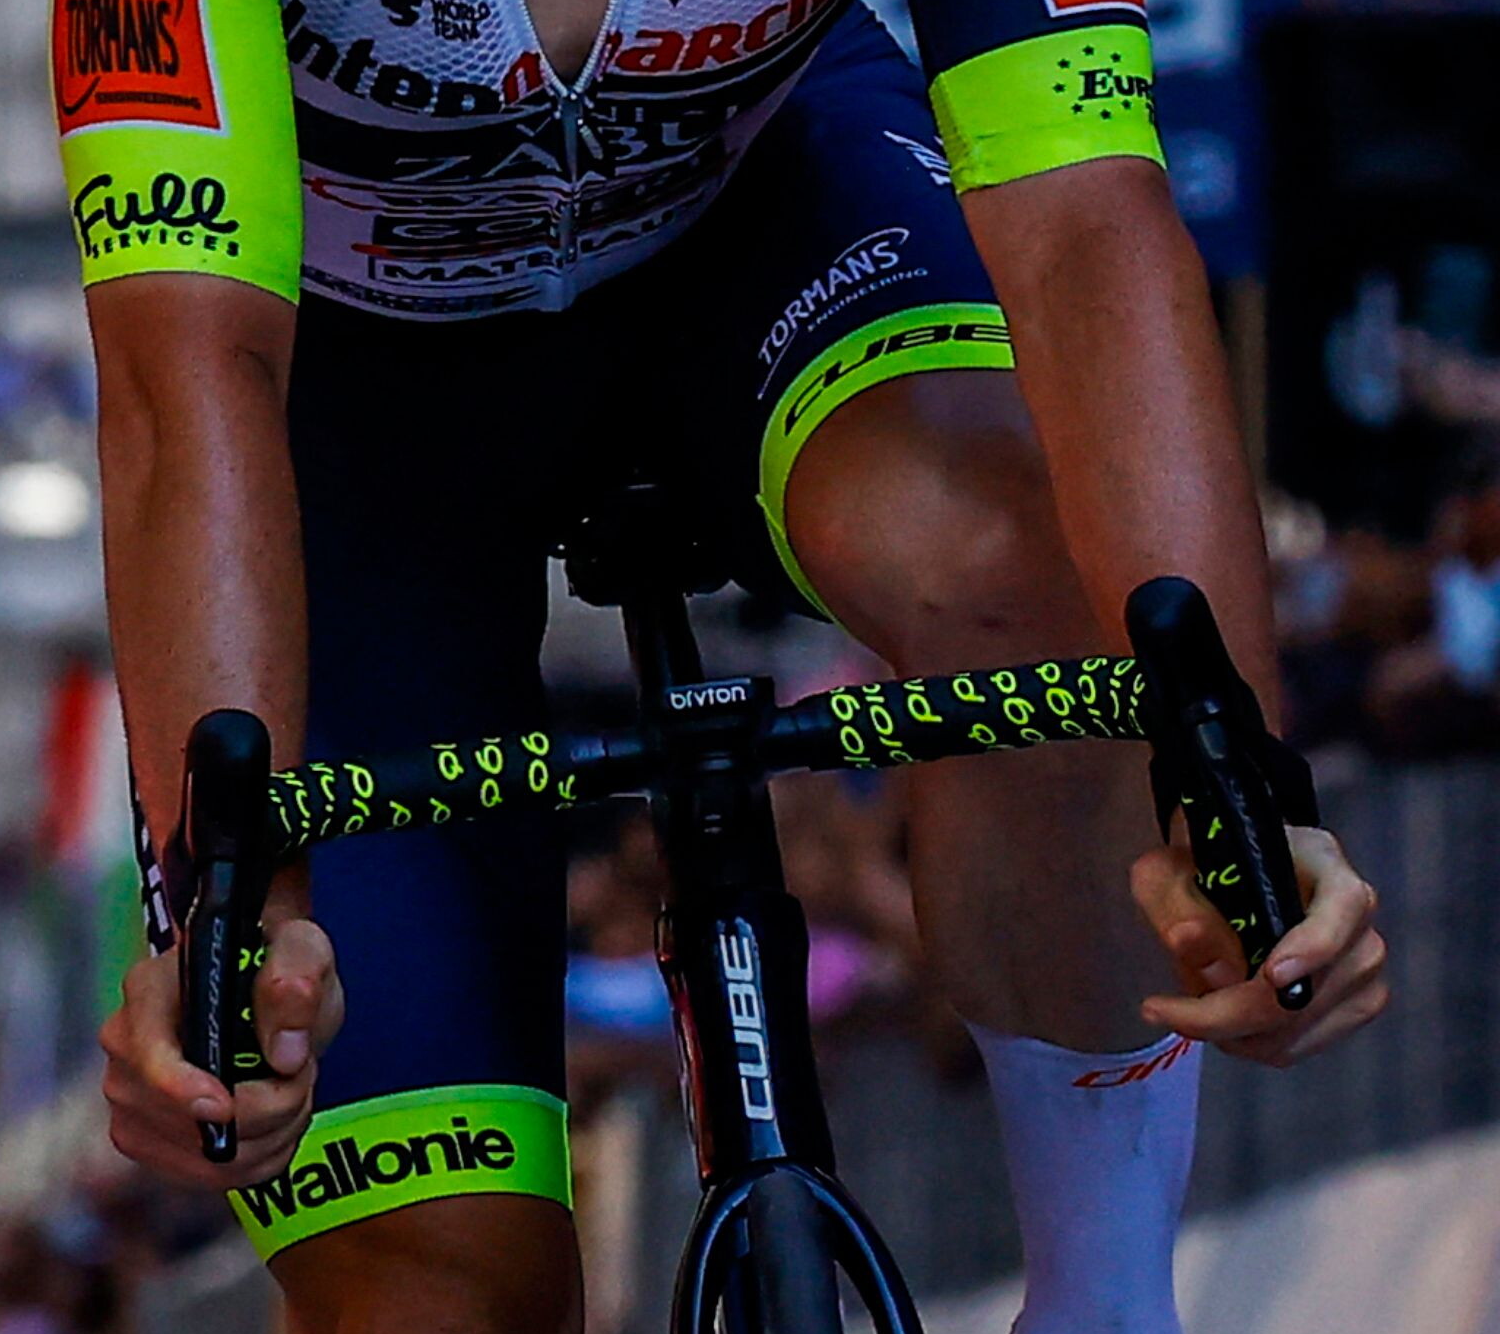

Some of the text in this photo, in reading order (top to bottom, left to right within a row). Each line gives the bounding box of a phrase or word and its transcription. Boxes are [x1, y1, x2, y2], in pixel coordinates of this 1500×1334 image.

[73, 171, 240, 259] Full
[90, 228, 240, 259] SERVICES
[757, 239, 901, 366] TORMANS
[806, 267, 929, 333] ENGINEERING
[718, 933, 775, 1121] CUBE
[236, 1114, 517, 1230] Wallonie
